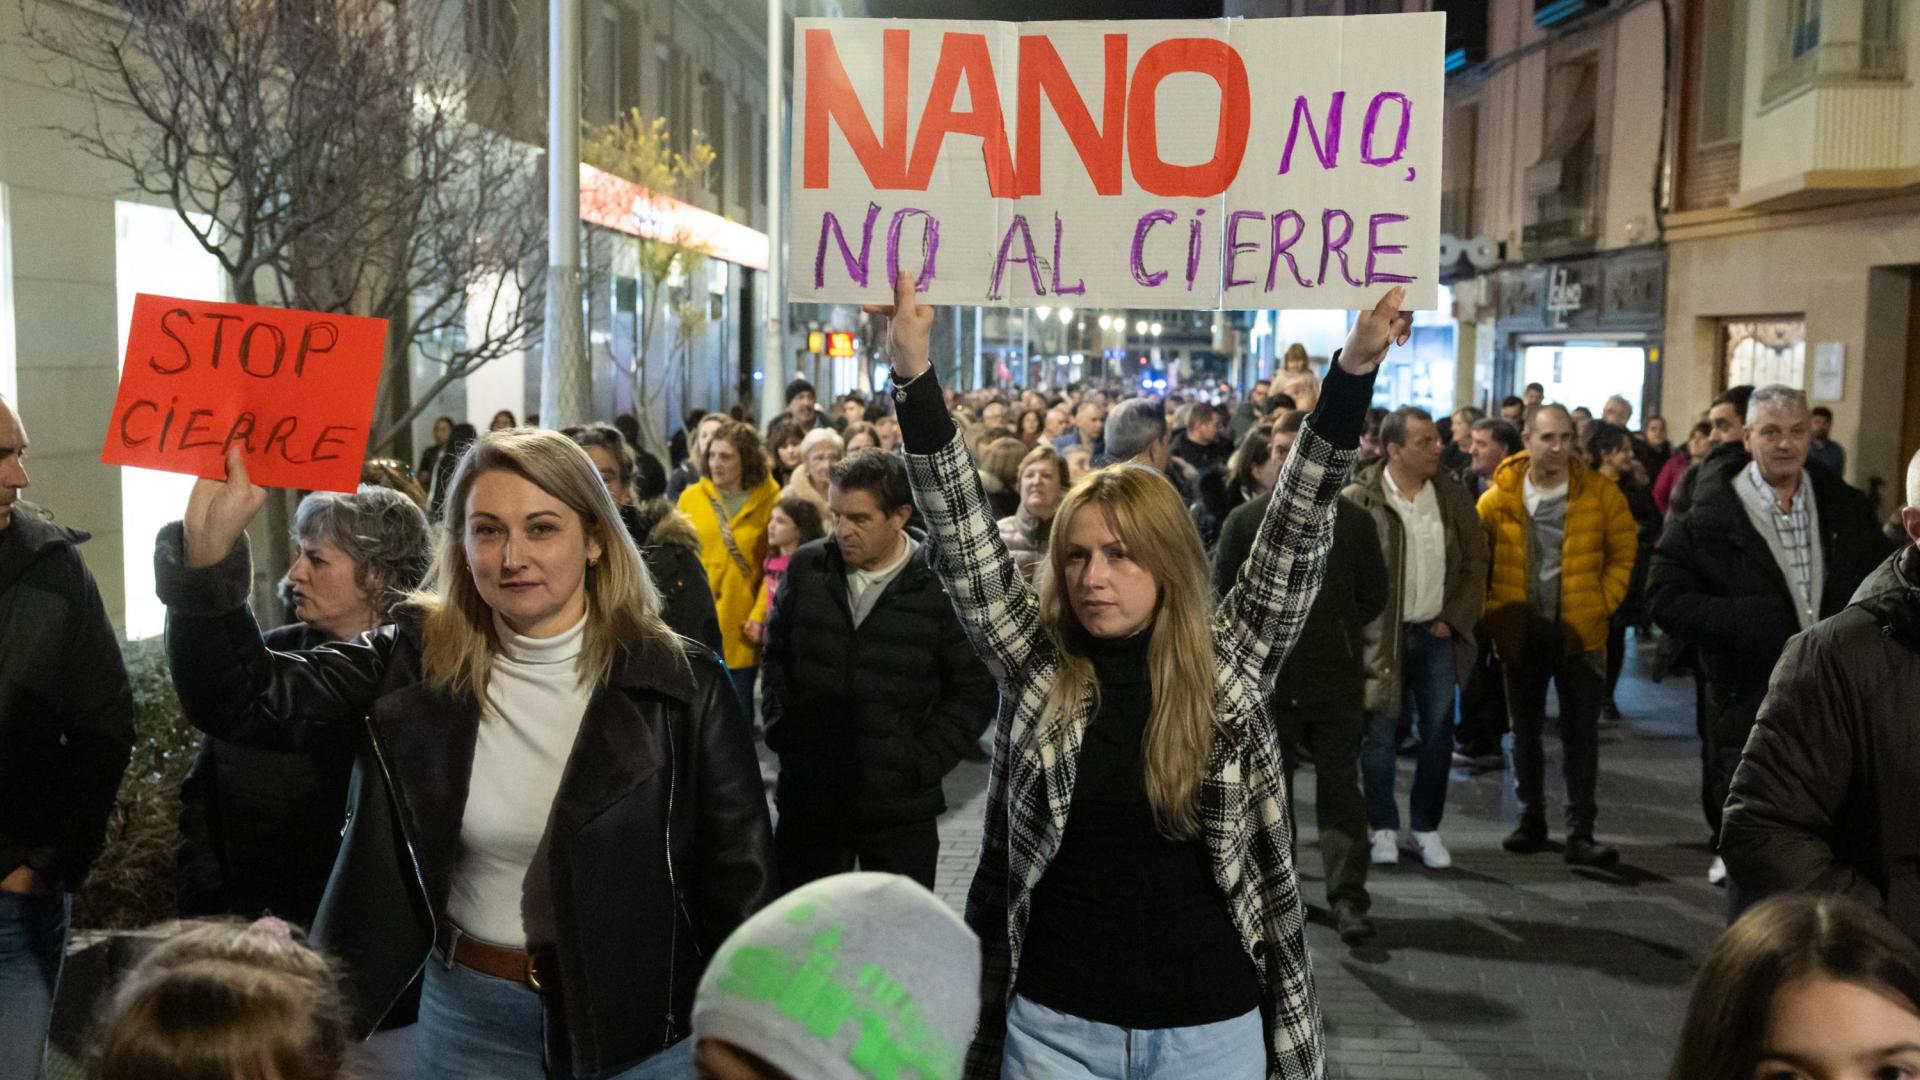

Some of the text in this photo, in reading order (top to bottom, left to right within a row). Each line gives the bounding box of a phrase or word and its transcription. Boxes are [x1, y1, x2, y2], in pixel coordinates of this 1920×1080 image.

[803, 28, 1416, 199] NANO NO,
[813, 202, 940, 292] NO
[986, 210, 1086, 300] AL
[149, 308, 339, 379] STOP
